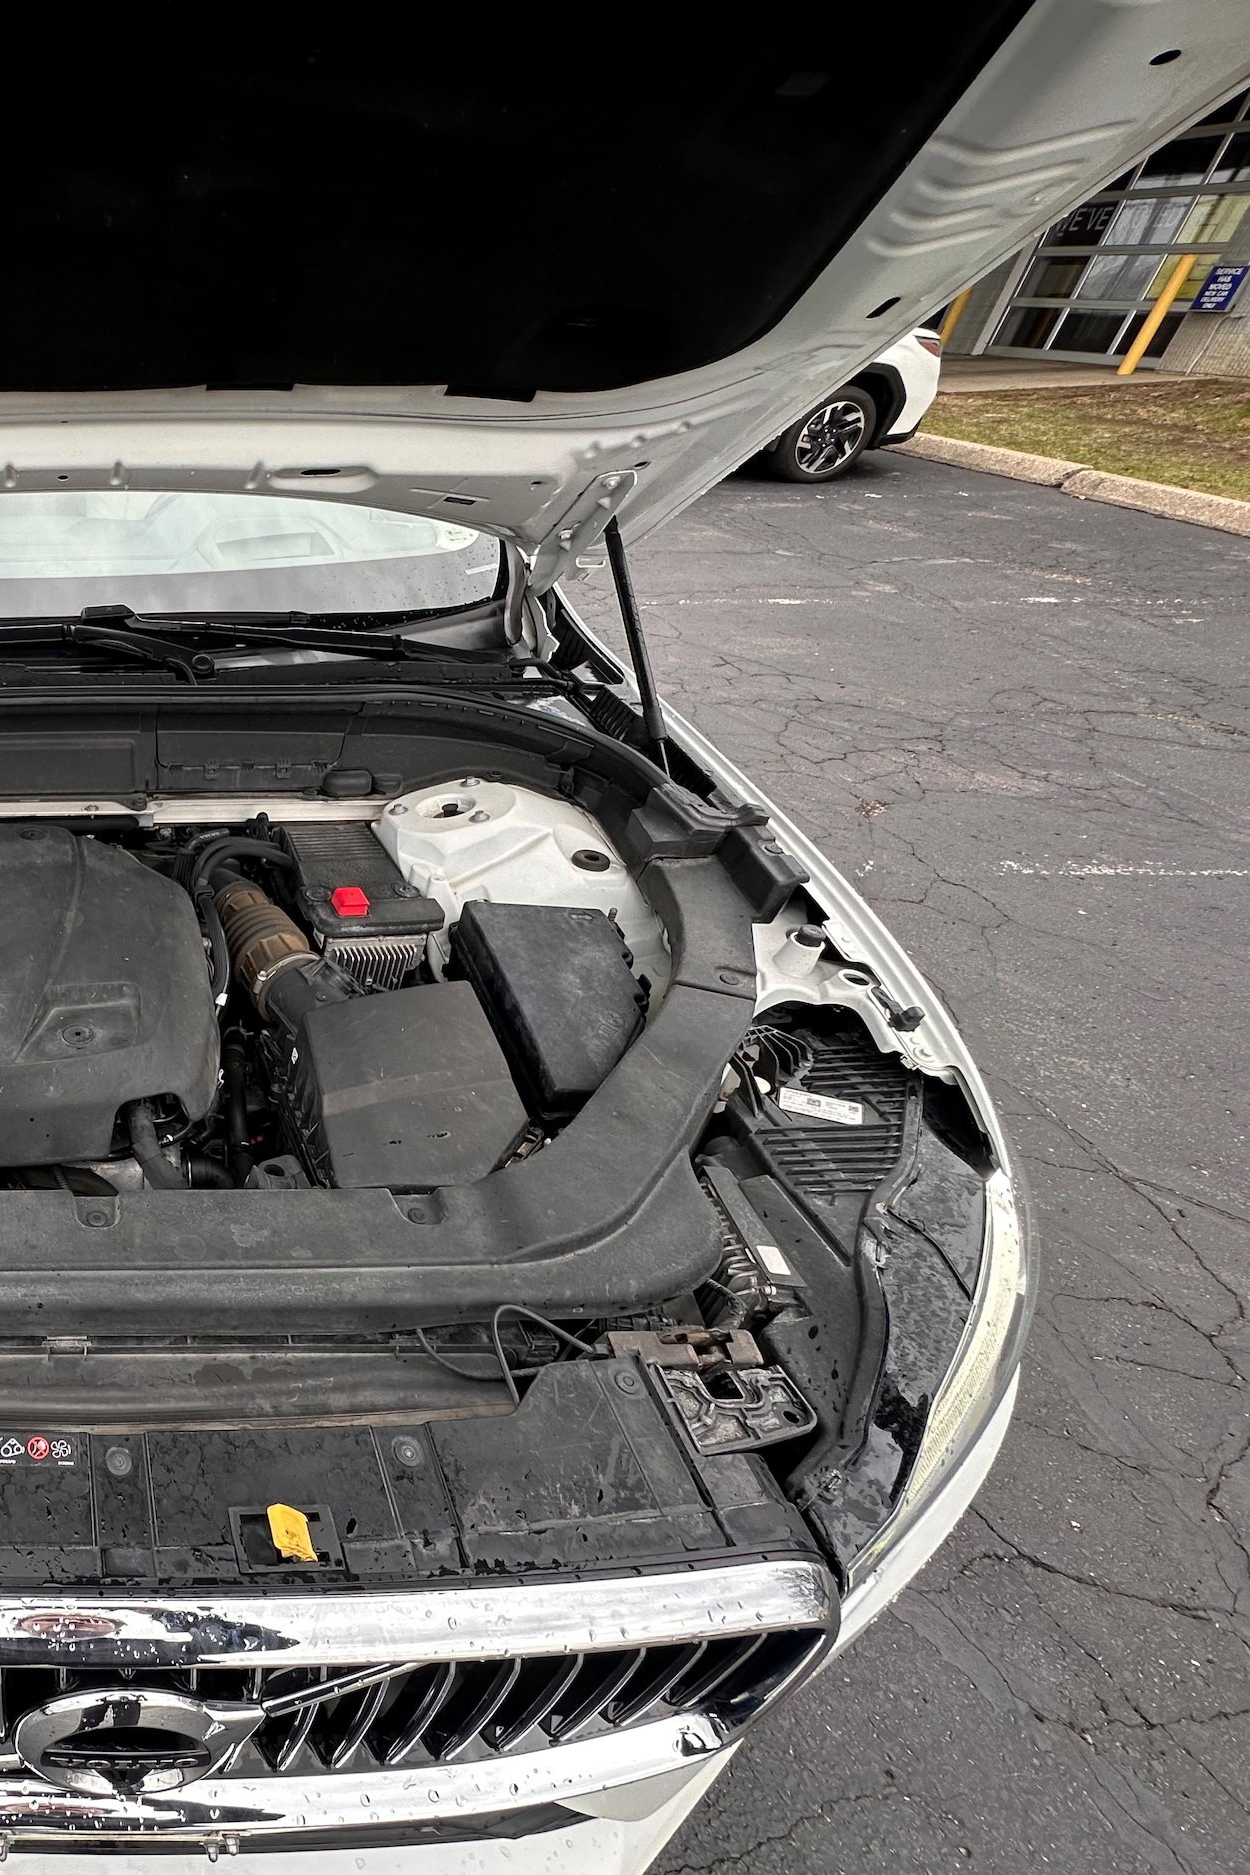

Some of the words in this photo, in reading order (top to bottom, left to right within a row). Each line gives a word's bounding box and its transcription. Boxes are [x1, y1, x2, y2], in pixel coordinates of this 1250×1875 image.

[1215, 267, 1244, 275] SERVICE
[1217, 275, 1232, 283] HAS
[49, 1756, 199, 1770] VOLVO
